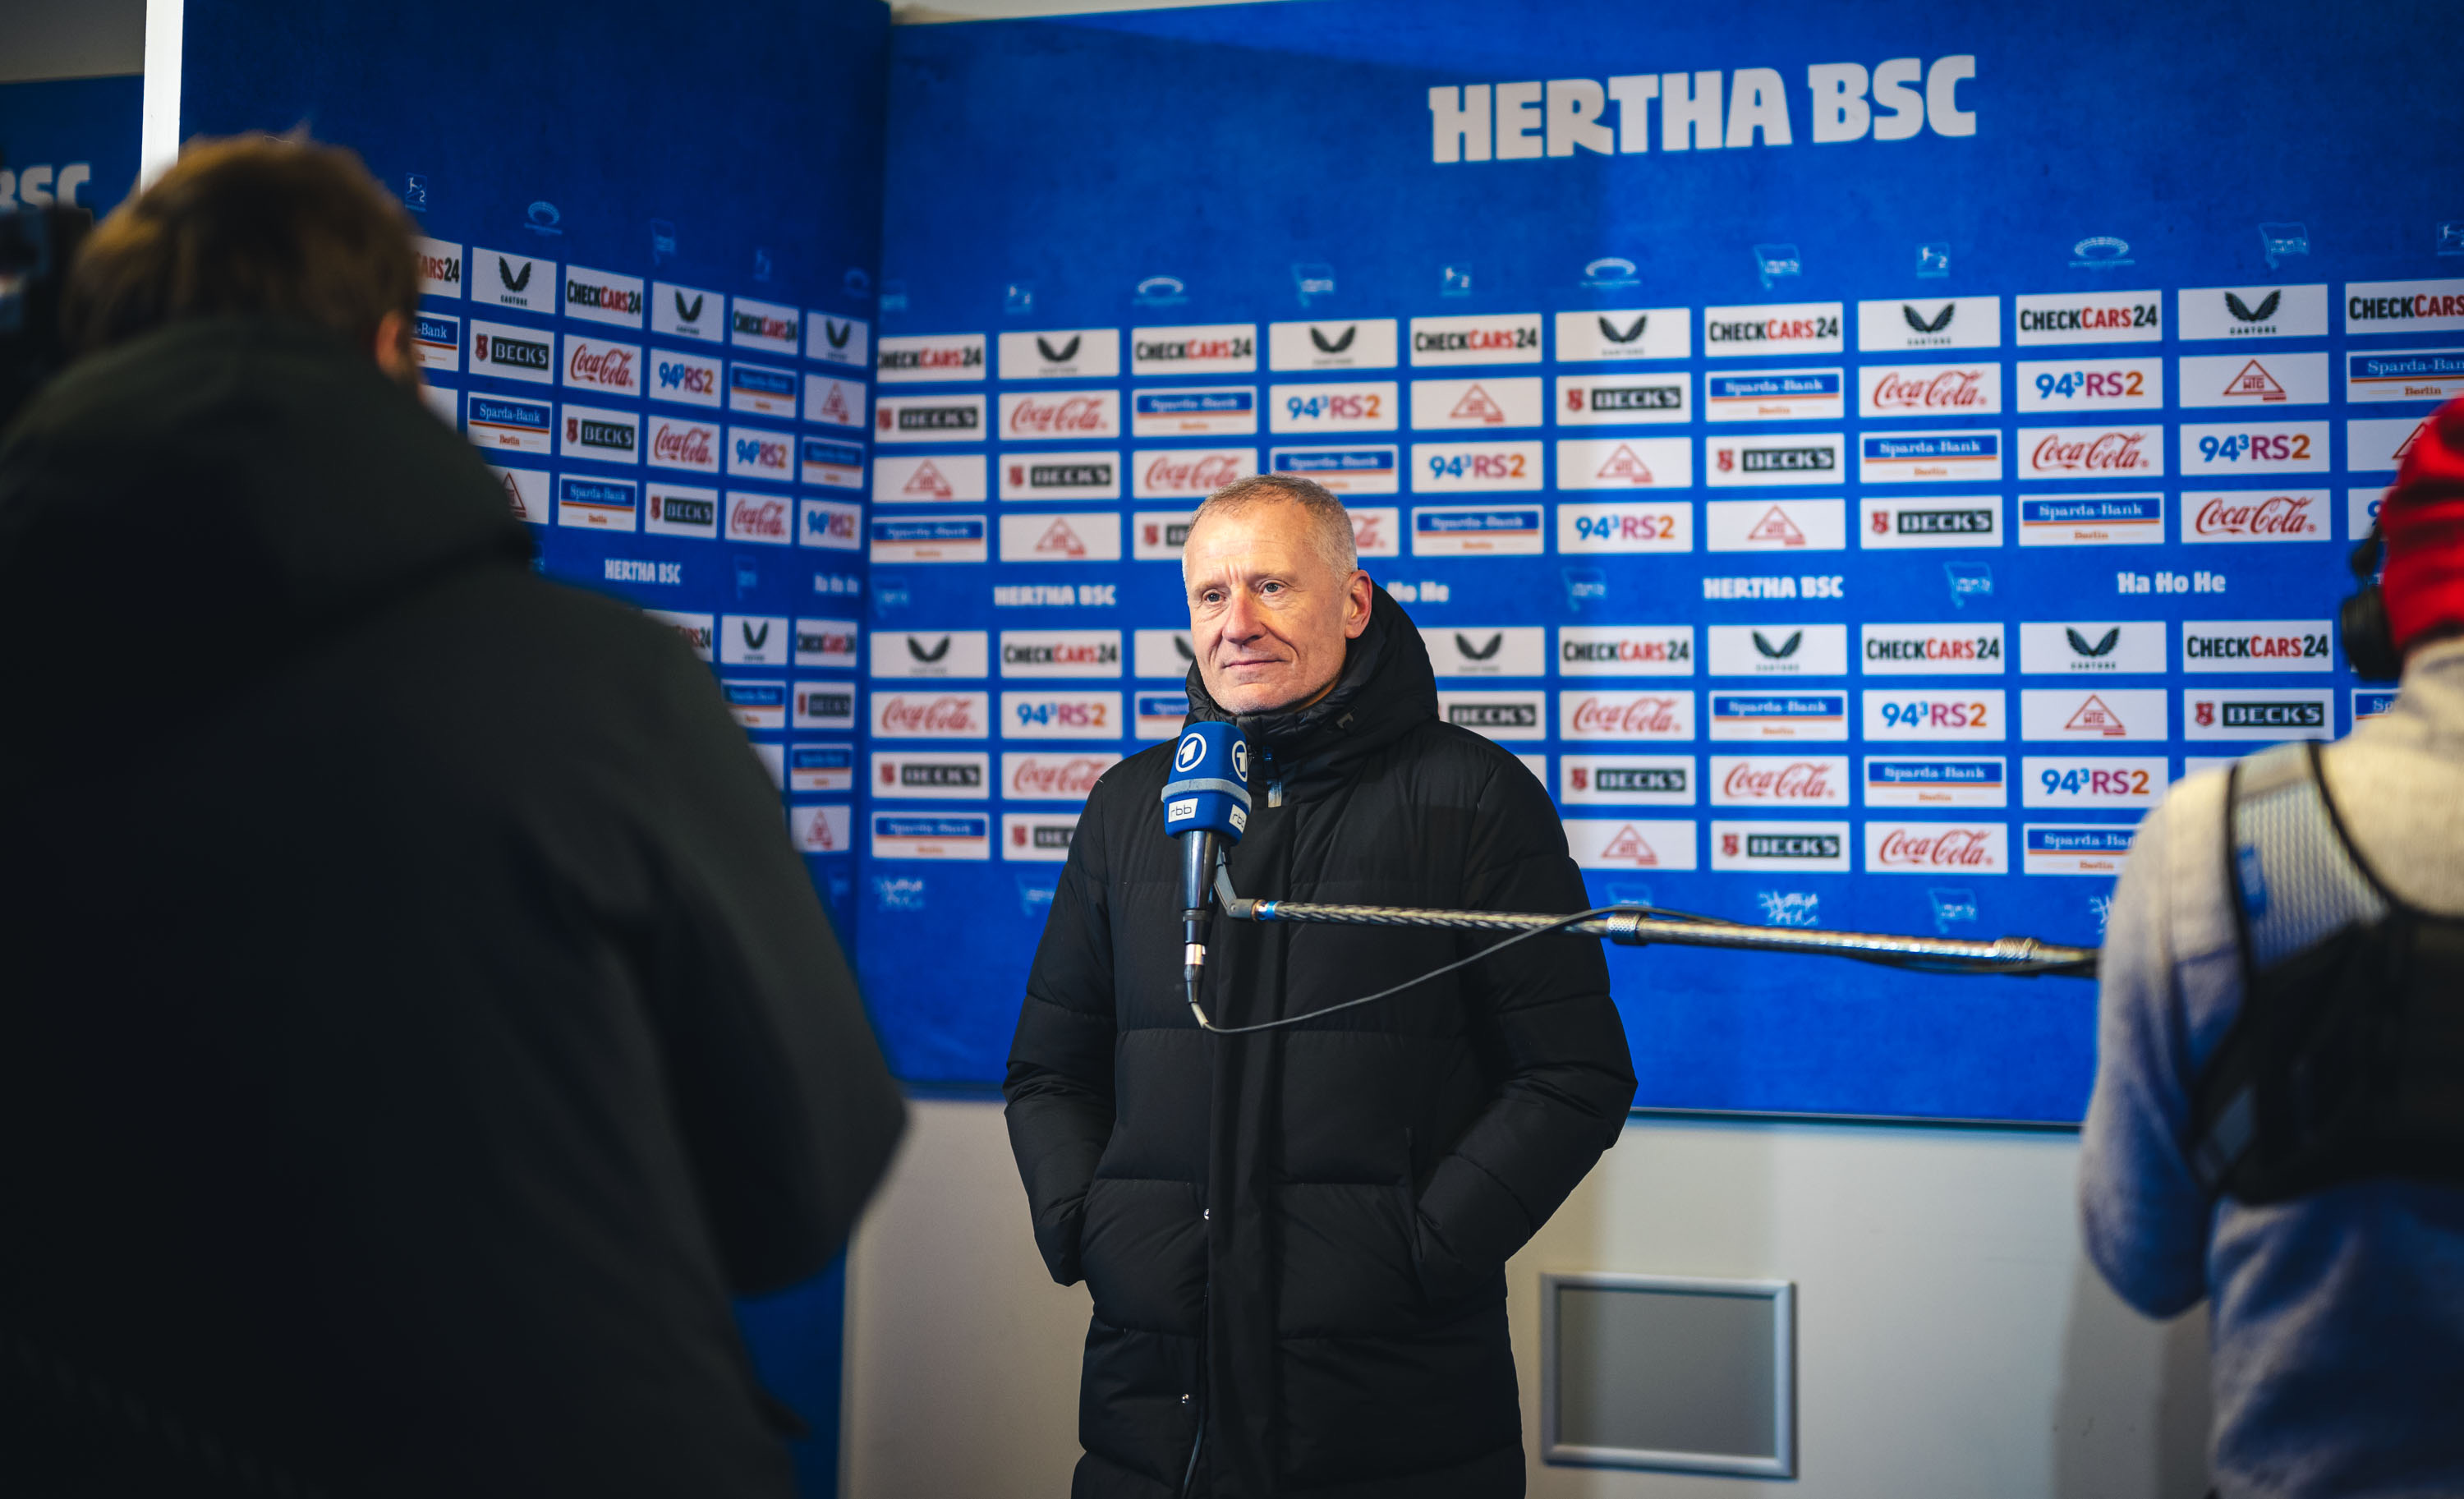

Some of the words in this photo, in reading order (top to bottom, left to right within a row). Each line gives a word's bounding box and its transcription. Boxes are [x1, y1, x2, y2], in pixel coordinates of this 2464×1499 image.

[1428, 67, 1793, 163] HERTHA
[1809, 55, 1976, 143] BSC
[500, 294, 527, 306] CASTORE
[567, 279, 641, 315] CHECKCARS24
[1709, 315, 1838, 343] CHECKCARS24
[2020, 304, 2157, 332] CHECKCARS24
[570, 343, 632, 387] Coca-Cola
[1873, 370, 1981, 407] Coca-Cola
[2405, 388, 2440, 396] Berlin
[479, 402, 539, 424] Sparda-Bank
[499, 435, 519, 446] Berlin
[654, 423, 710, 464] Coca-Cola
[2032, 432, 2144, 470] Coca-Cola
[1902, 513, 1988, 531] BECK'S
[2038, 502, 2141, 518] Sparda-Bank
[2195, 496, 2310, 534] Coca-Cola
[605, 559, 655, 583] HERTHA
[659, 560, 683, 584] BSC
[2118, 573, 2150, 594] Ha
[2155, 572, 2188, 593] Ho
[2194, 572, 2226, 592] He
[1703, 577, 1796, 600] HERTHA
[1801, 576, 1844, 598] BSC
[1564, 639, 1689, 662] CHECKCARS24
[1867, 637, 2000, 660] CHECKCARS24
[2187, 635, 2328, 659] CHECKCARS24
[1574, 697, 1676, 731] Coca-Cola
[2227, 706, 2319, 724] BECK'S
[1724, 761, 1830, 797] Coca-Cola
[1170, 804, 1193, 817] rbb
[1879, 828, 1988, 865] Coca-Cola
